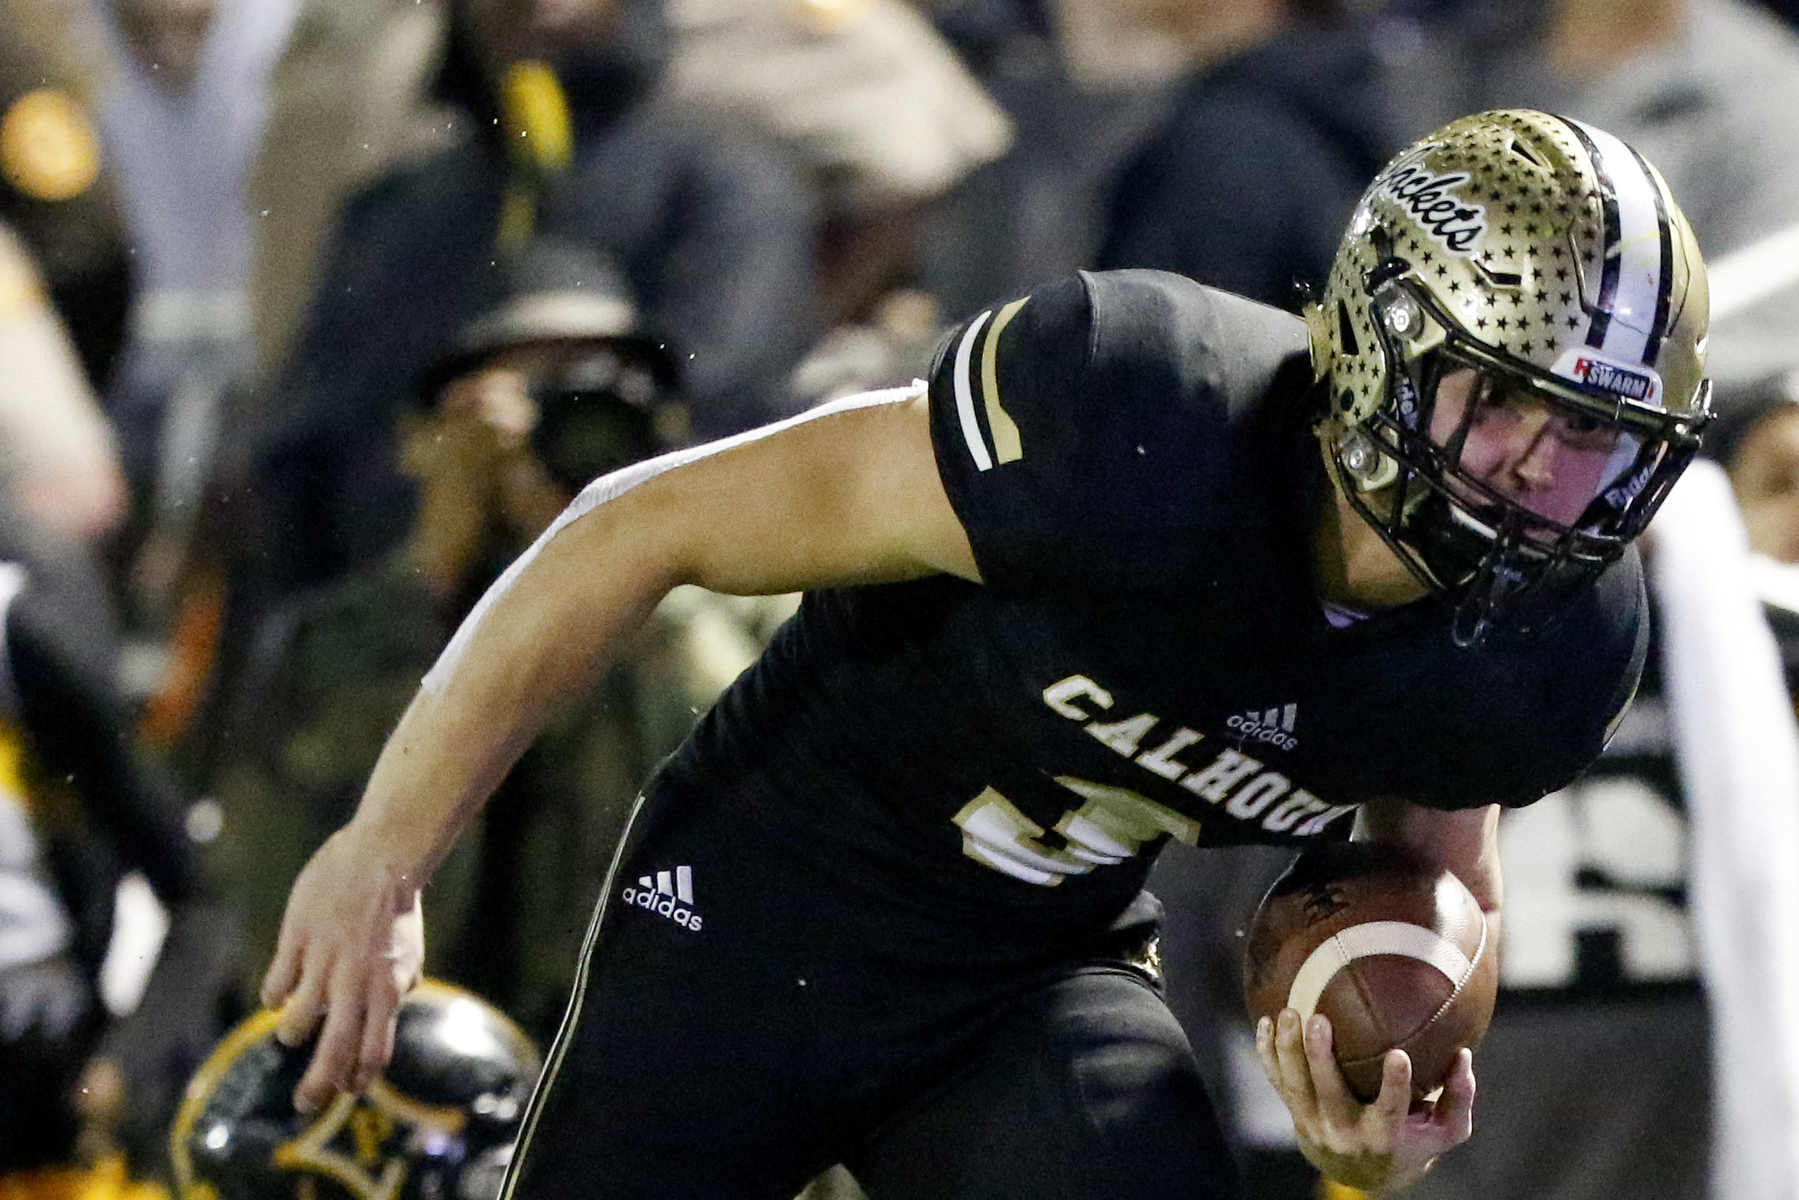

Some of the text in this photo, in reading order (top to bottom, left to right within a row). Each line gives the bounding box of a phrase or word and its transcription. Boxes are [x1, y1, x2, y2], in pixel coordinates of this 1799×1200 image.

[1587, 364, 1646, 399] SWARM
[1226, 714, 1298, 751] adidas
[622, 887, 703, 932] adidas
